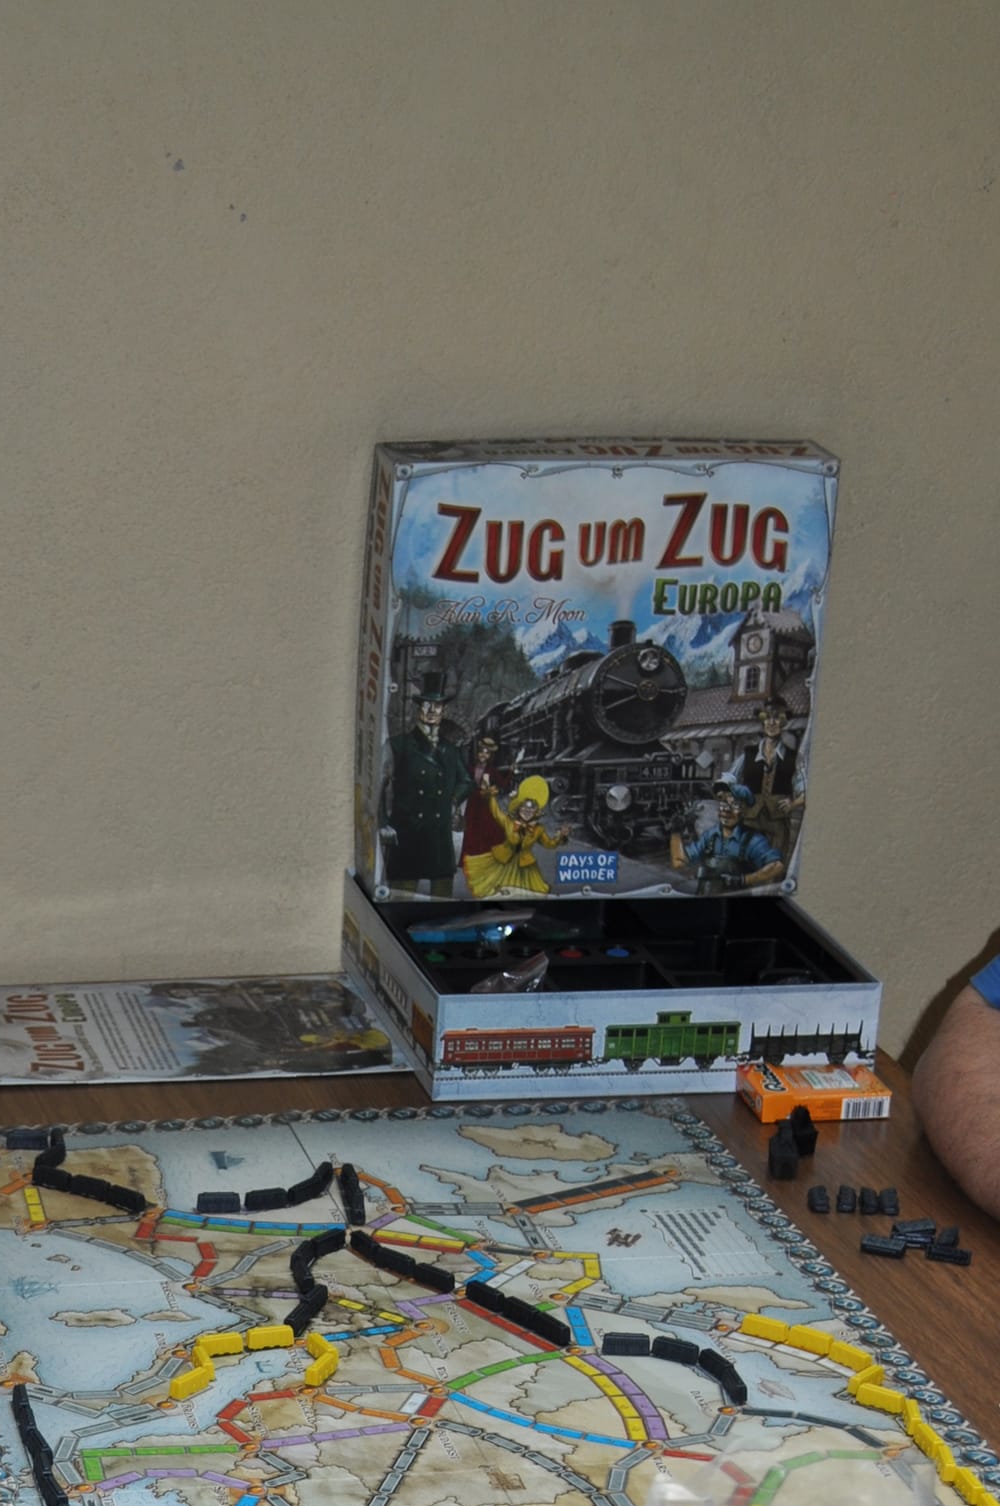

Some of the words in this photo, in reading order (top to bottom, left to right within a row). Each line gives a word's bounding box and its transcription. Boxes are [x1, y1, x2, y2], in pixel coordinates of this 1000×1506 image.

[432, 501, 566, 584] ZUG
[655, 492, 790, 572] ZUG
[425, 595, 486, 627] Alan
[525, 597, 586, 625] Moon
[653, 578, 783, 617] EUROPA
[559, 854, 593, 868] DAYS
[597, 854, 616, 867] OF
[559, 868, 615, 882] WONDER
[3, 993, 57, 1024] ZUG
[31, 1043, 85, 1072] ZUG
